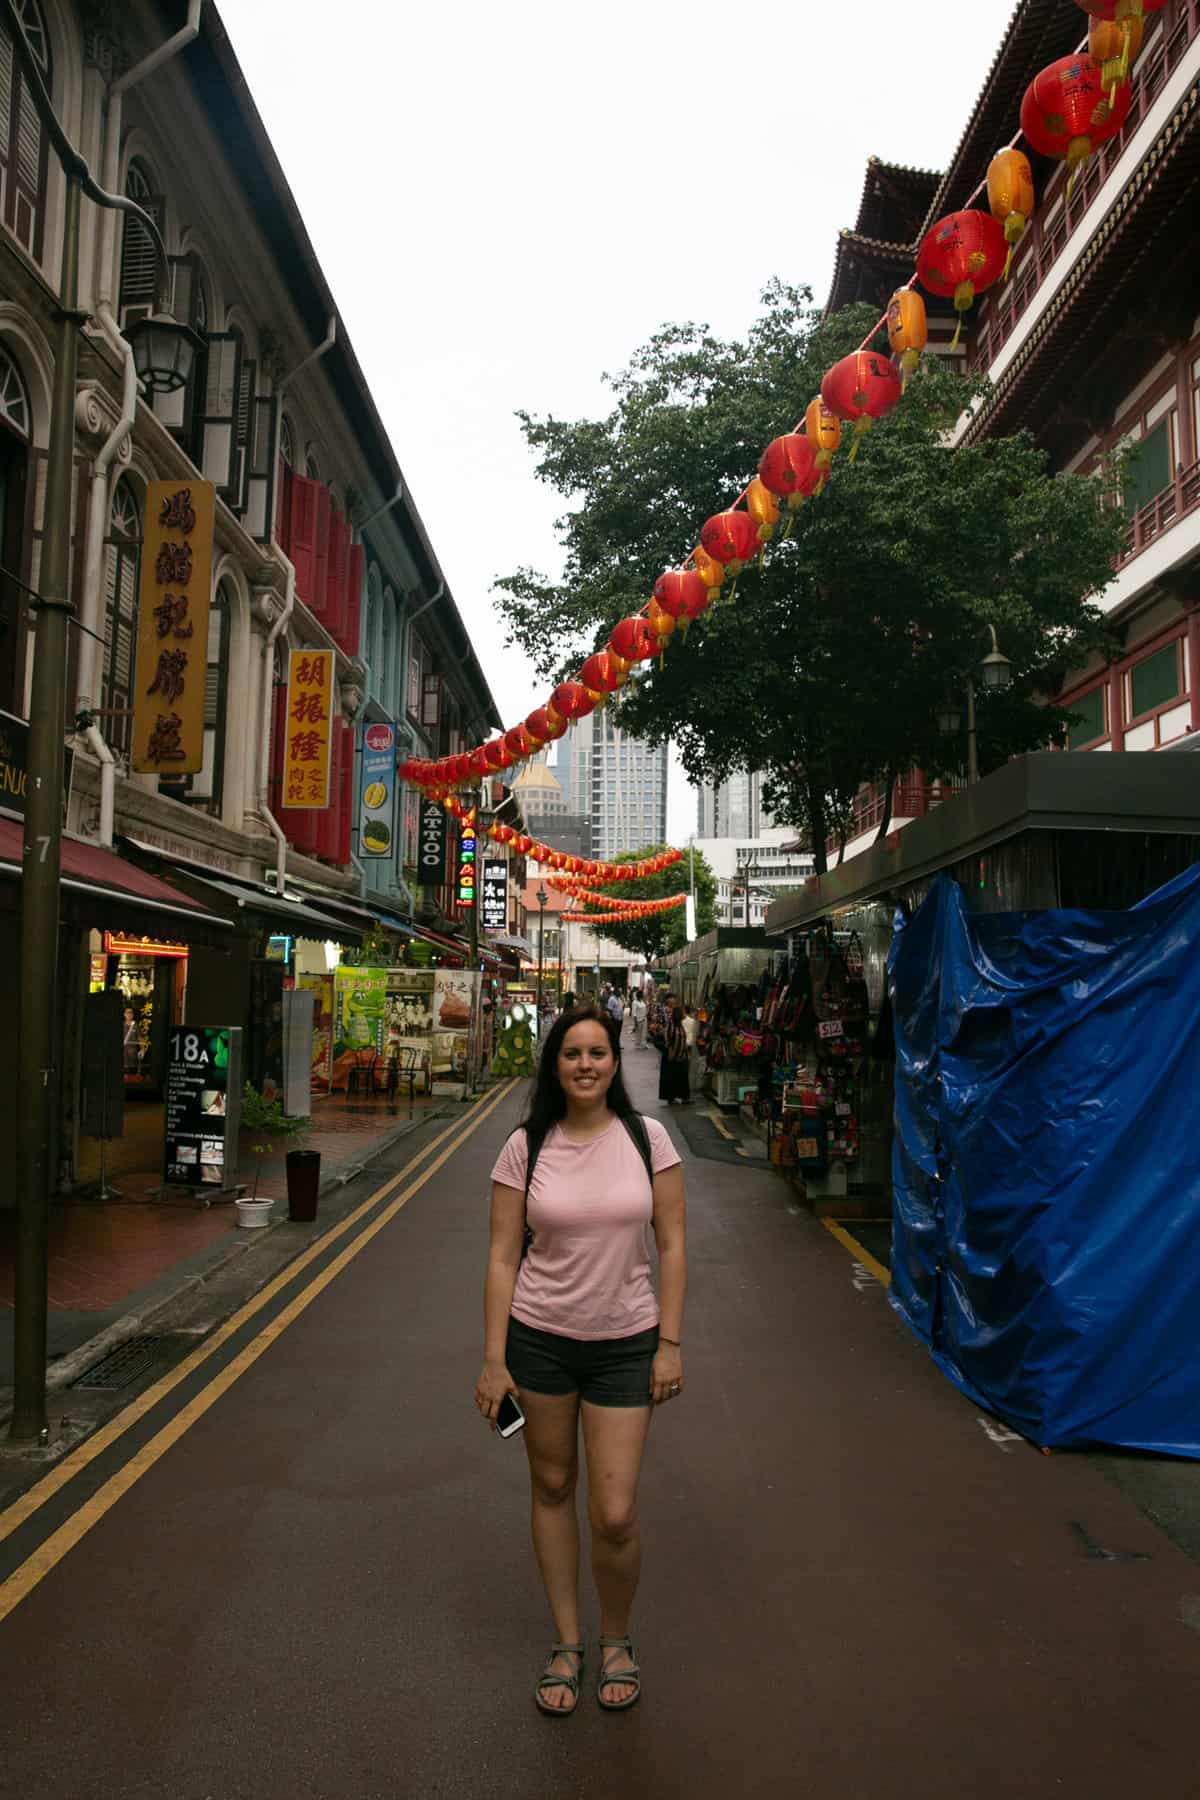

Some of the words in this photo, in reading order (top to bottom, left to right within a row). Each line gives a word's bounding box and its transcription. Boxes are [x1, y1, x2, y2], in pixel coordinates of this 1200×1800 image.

[290, 655, 328, 761] 胡振隆
[35, 836, 51, 863] 7
[422, 800, 444, 866] ATTOO
